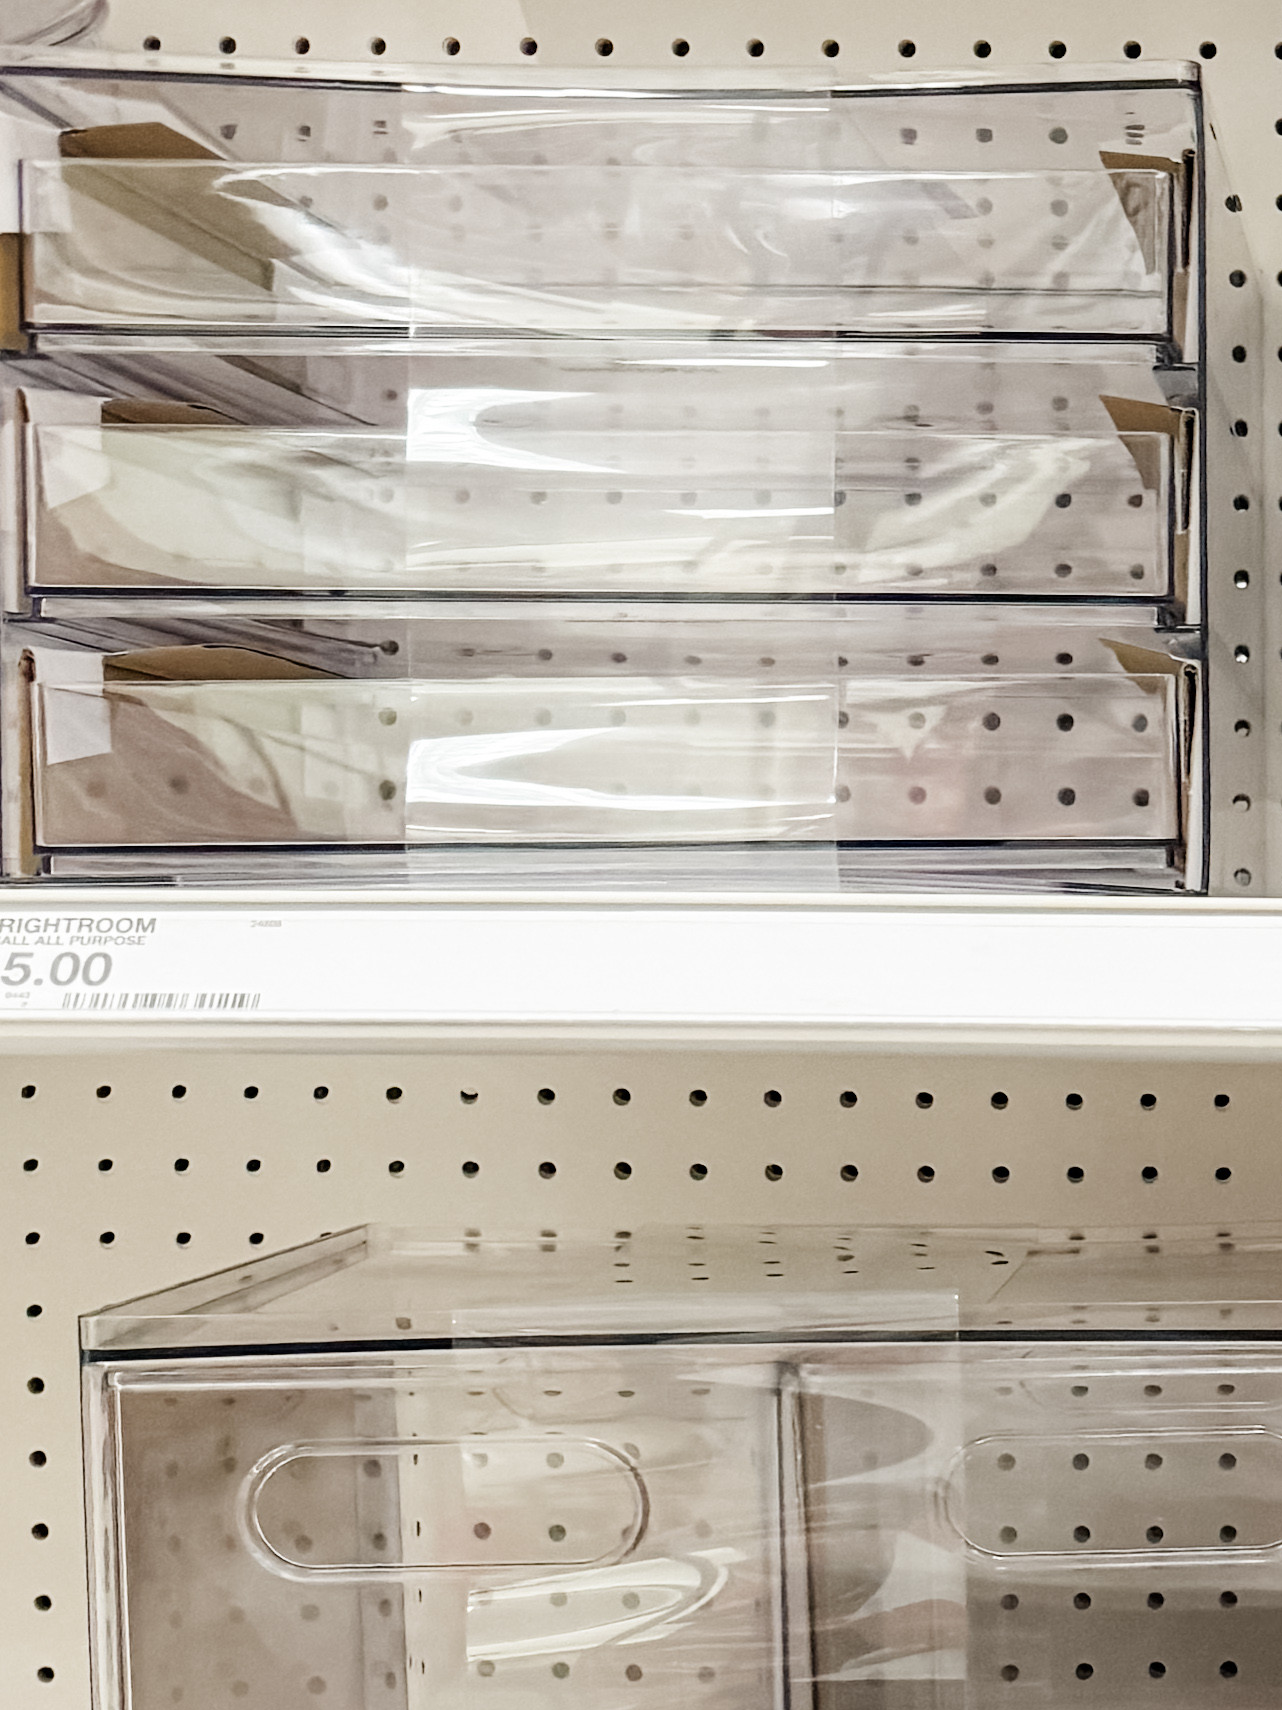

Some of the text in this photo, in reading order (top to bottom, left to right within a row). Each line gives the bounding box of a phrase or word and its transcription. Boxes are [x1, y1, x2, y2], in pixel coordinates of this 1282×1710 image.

[0, 917, 157, 934] RIGHTROOM
[33, 935, 65, 946] ALL
[68, 935, 147, 946] PURPOSE
